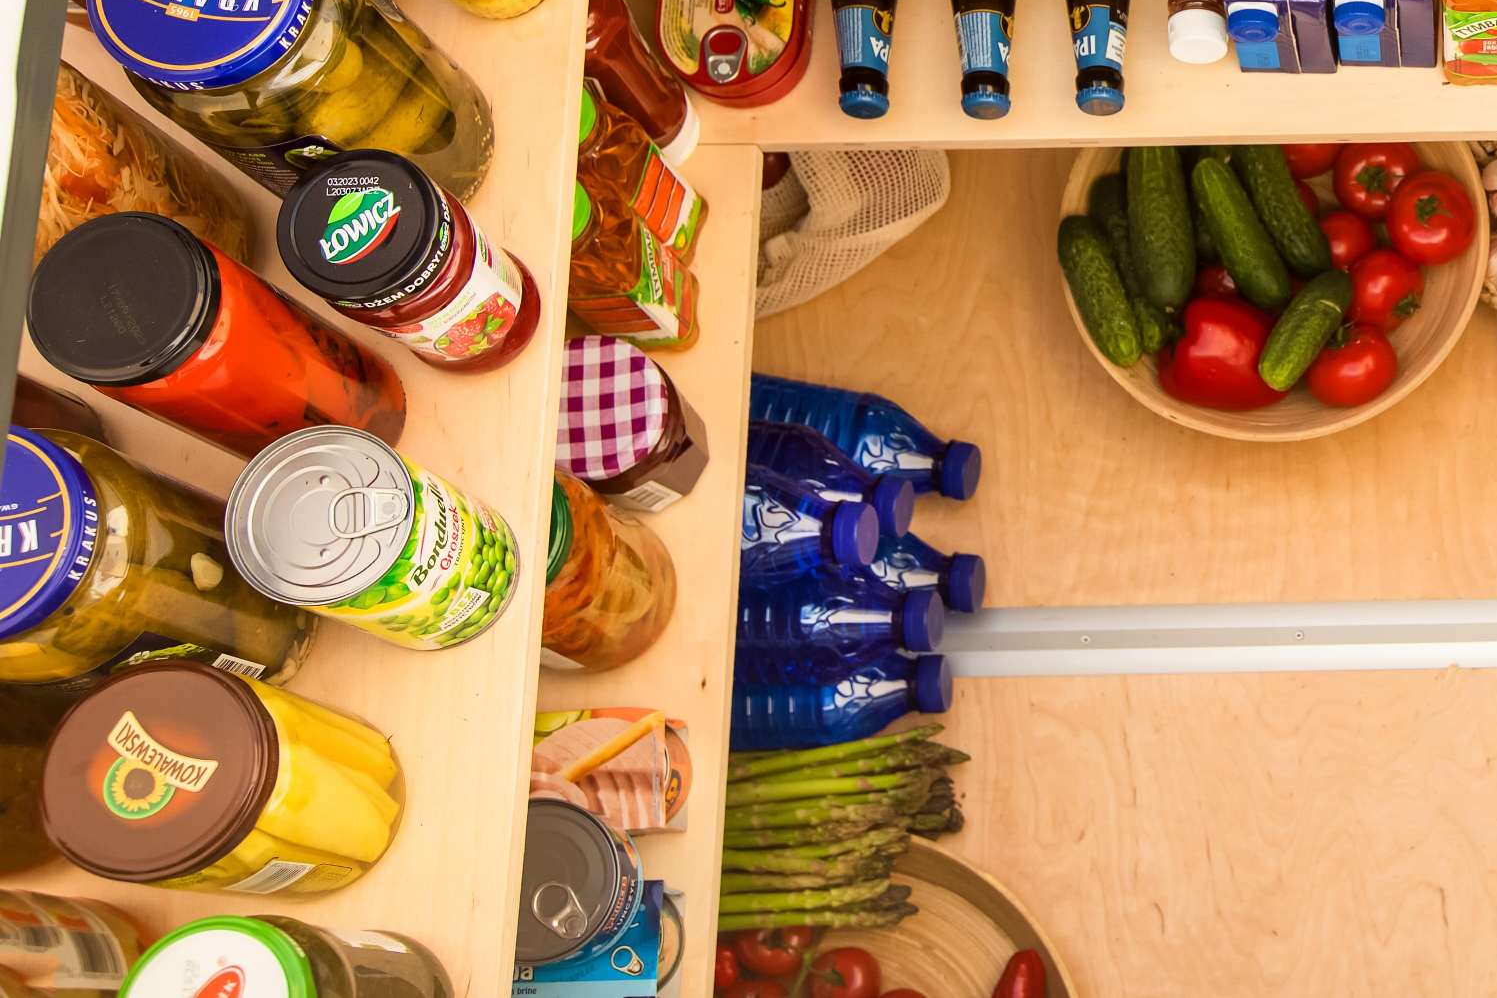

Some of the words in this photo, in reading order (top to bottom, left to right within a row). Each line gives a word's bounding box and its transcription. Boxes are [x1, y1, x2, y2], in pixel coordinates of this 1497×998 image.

[170, 6, 195, 19] 1965
[360, 177, 380, 185] 0042
[319, 193, 401, 261] ŁOWICZ
[364, 291, 405, 309] DŻEM
[404, 251, 443, 294] DOBRY!
[68, 495, 98, 581] KRAKUS
[440, 505, 459, 571] Groszek
[115, 722, 207, 787] KOWALEWSKI
[516, 986, 537, 996] brine
